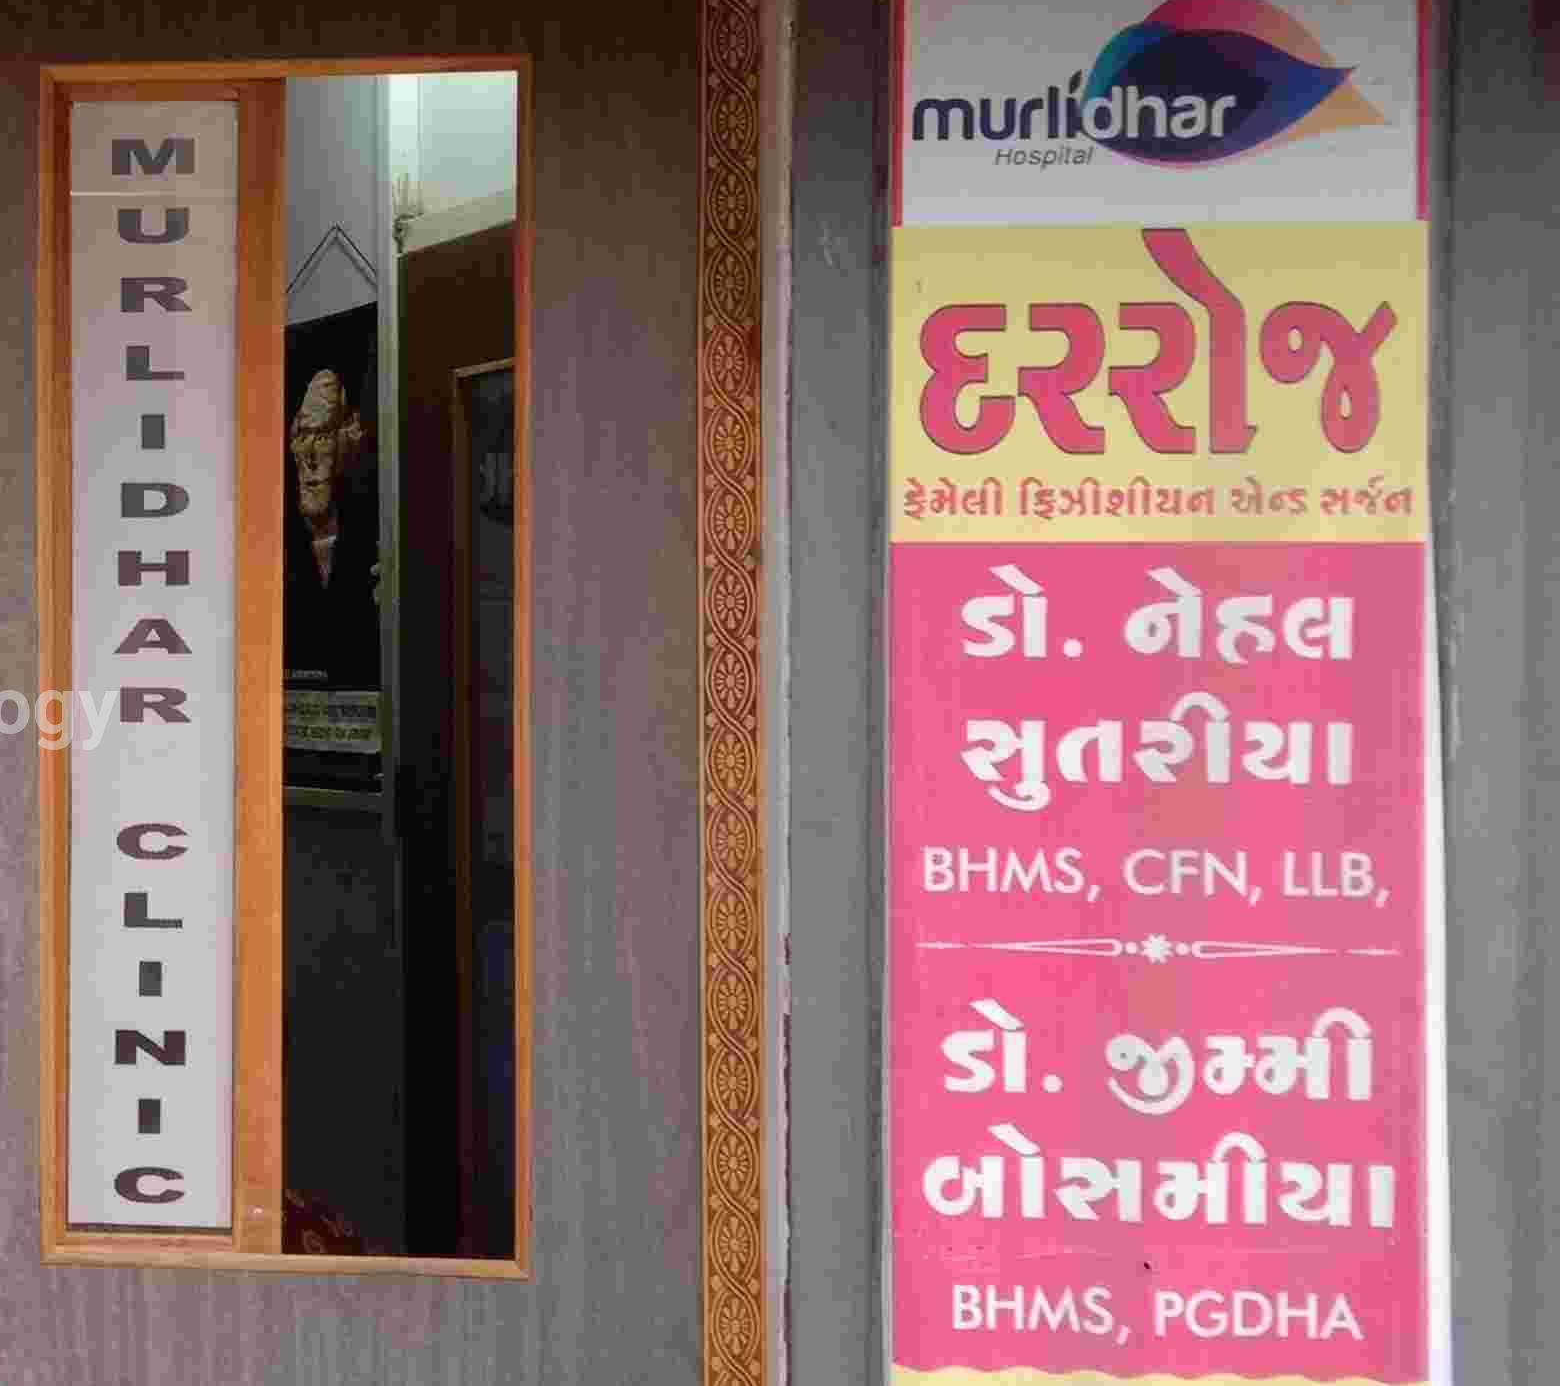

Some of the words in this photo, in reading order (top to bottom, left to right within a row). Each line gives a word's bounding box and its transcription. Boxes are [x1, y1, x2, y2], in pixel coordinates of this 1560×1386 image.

[911, 70, 1238, 140] murlidhar
[994, 146, 1095, 170] Hospital
[919, 228, 1398, 455] દરરોજ
[110, 137, 196, 724] MURLIDHAR
[959, 564, 1083, 659] ડો.
[1123, 565, 1354, 665] નેહલ
[960, 690, 1354, 810] સુતરીયા
[922, 846, 1102, 903] BHMS,
[1123, 849, 1262, 905] CFN,
[1281, 851, 1390, 908] LLB,
[113, 823, 190, 1205] CLINIC
[940, 997, 1064, 1095] ડો.
[1104, 1006, 1372, 1116] જીમ્મી
[922, 1123, 1395, 1229] બોસમીયા
[951, 1284, 1131, 1346] BHMS,
[1153, 1288, 1365, 1342] PGDHA
